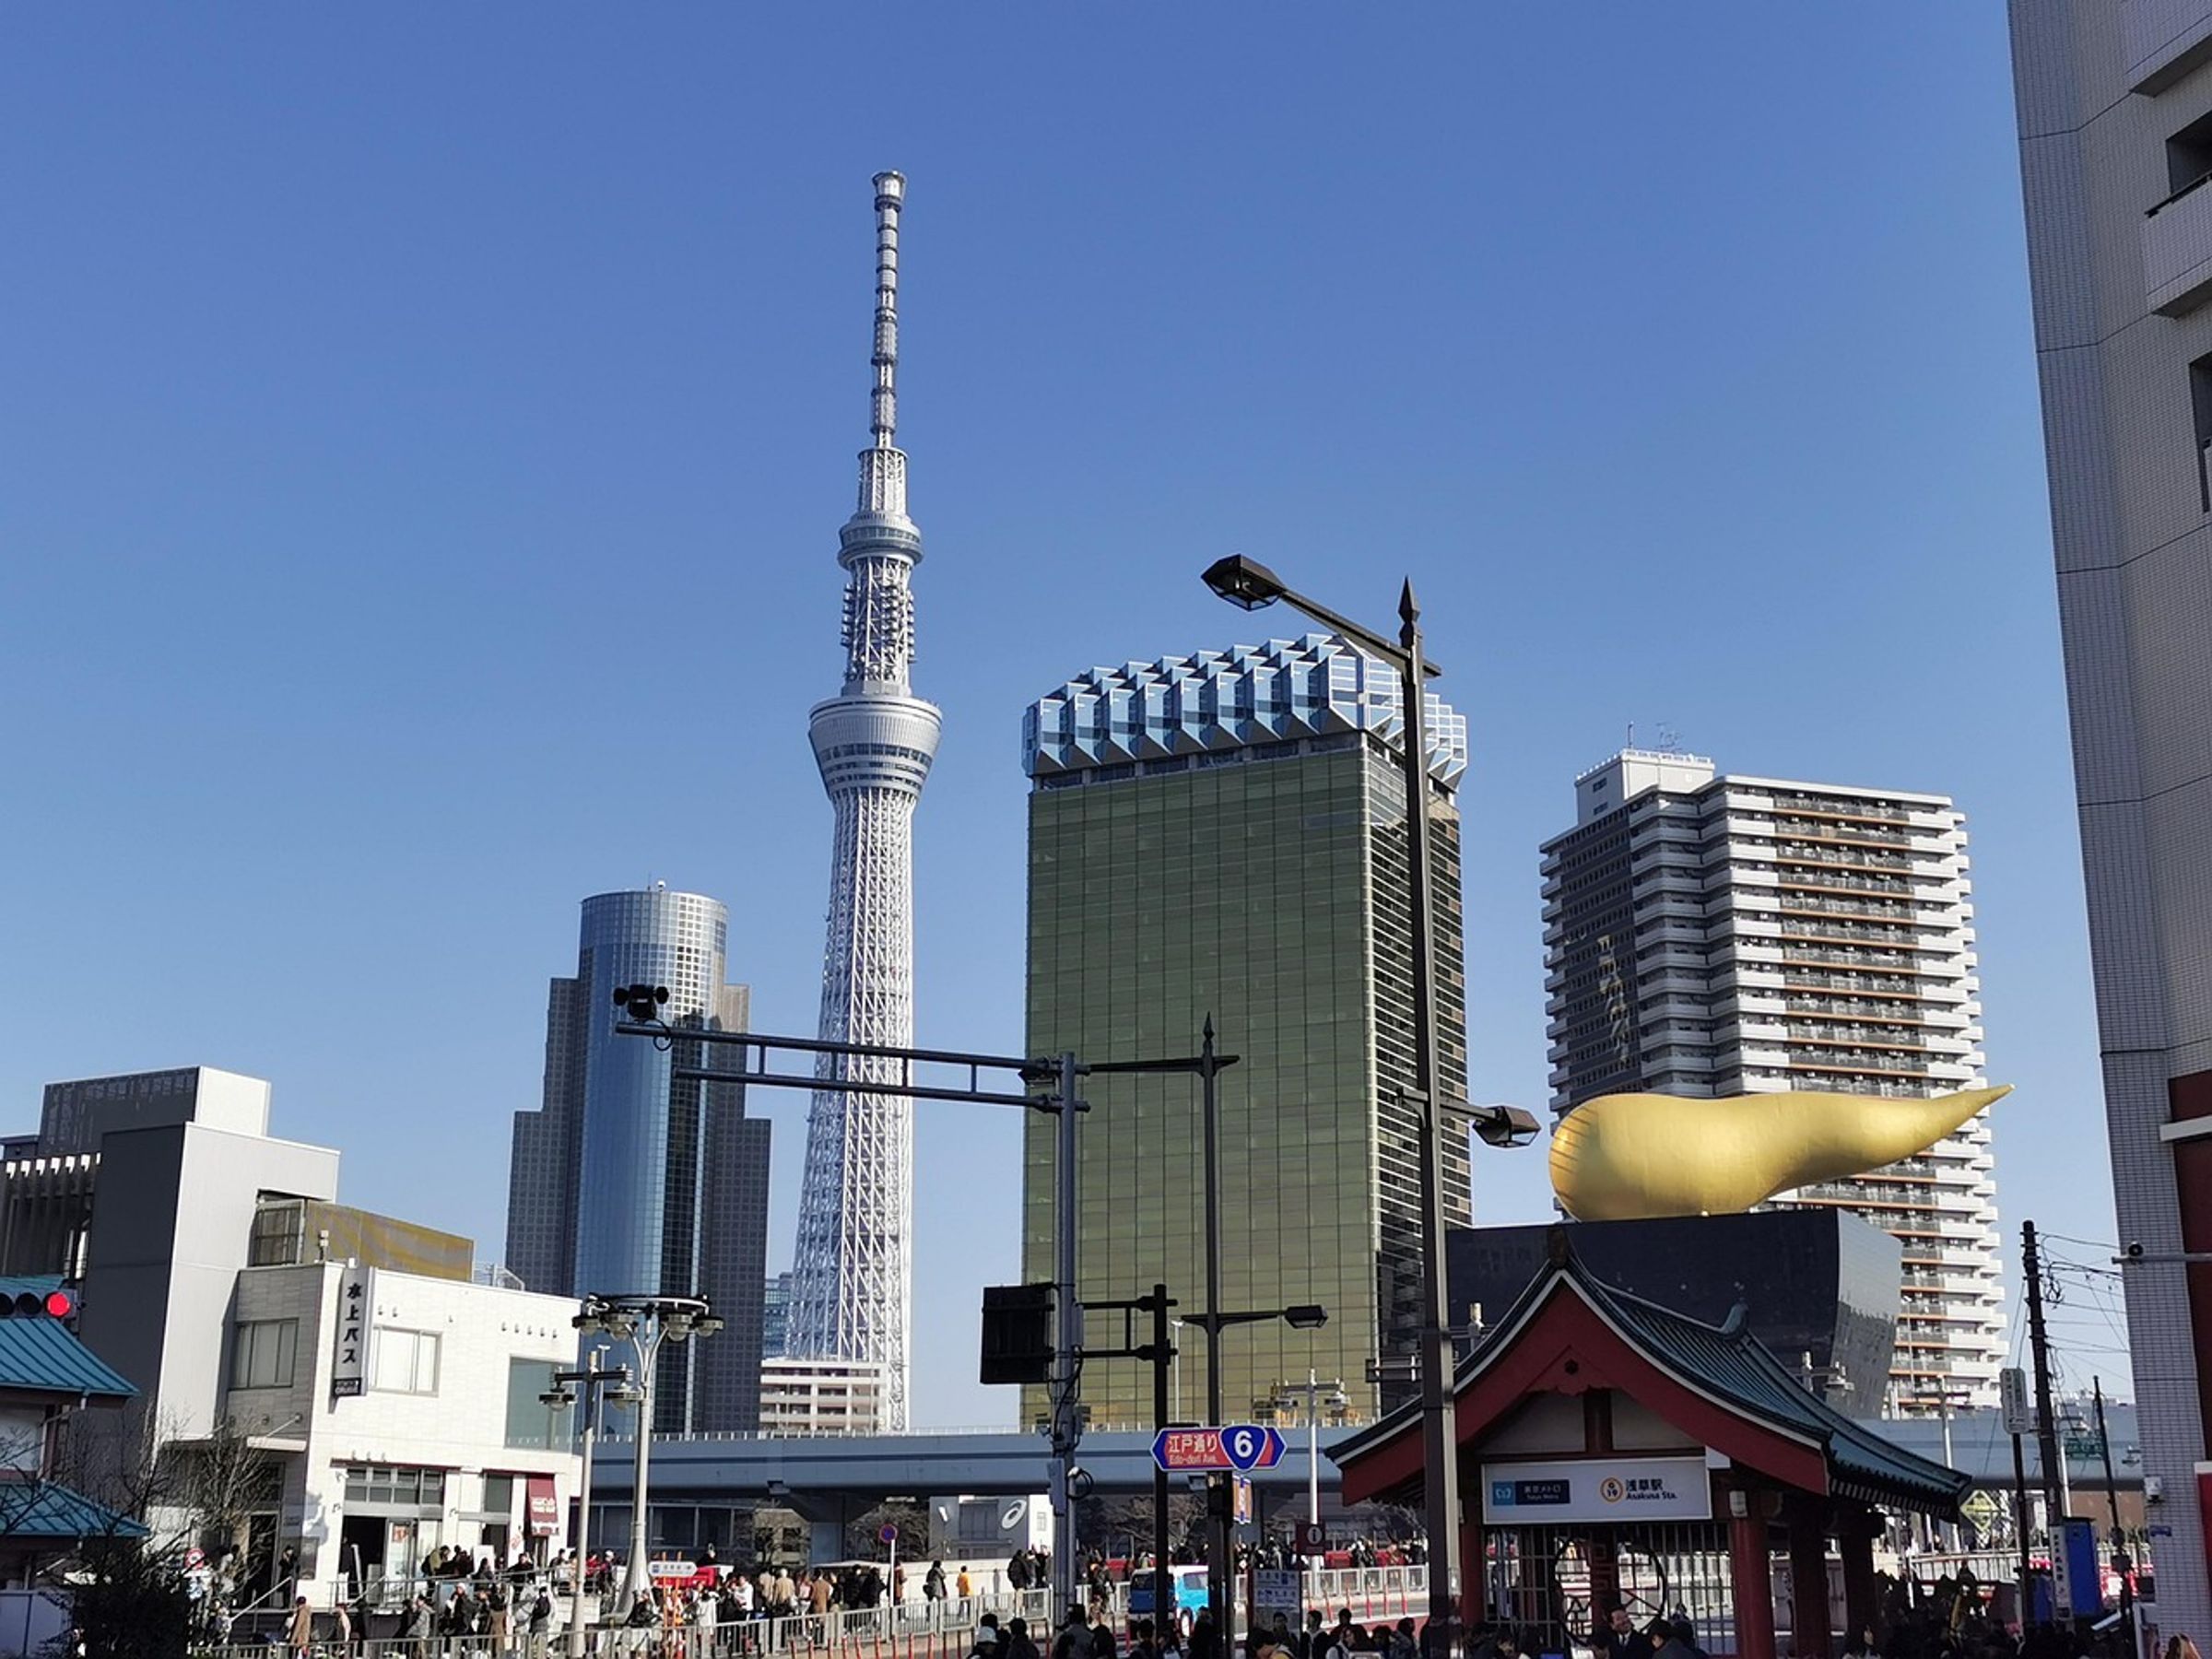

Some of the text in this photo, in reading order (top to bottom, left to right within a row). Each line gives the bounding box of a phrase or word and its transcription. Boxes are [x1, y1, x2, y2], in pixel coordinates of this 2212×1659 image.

[343, 1282, 362, 1364] 水上バス
[1168, 1433, 1218, 1453] 江戸通り
[1235, 1430, 1253, 1457] 6
[1626, 1478, 1664, 1491] 浅草駅
